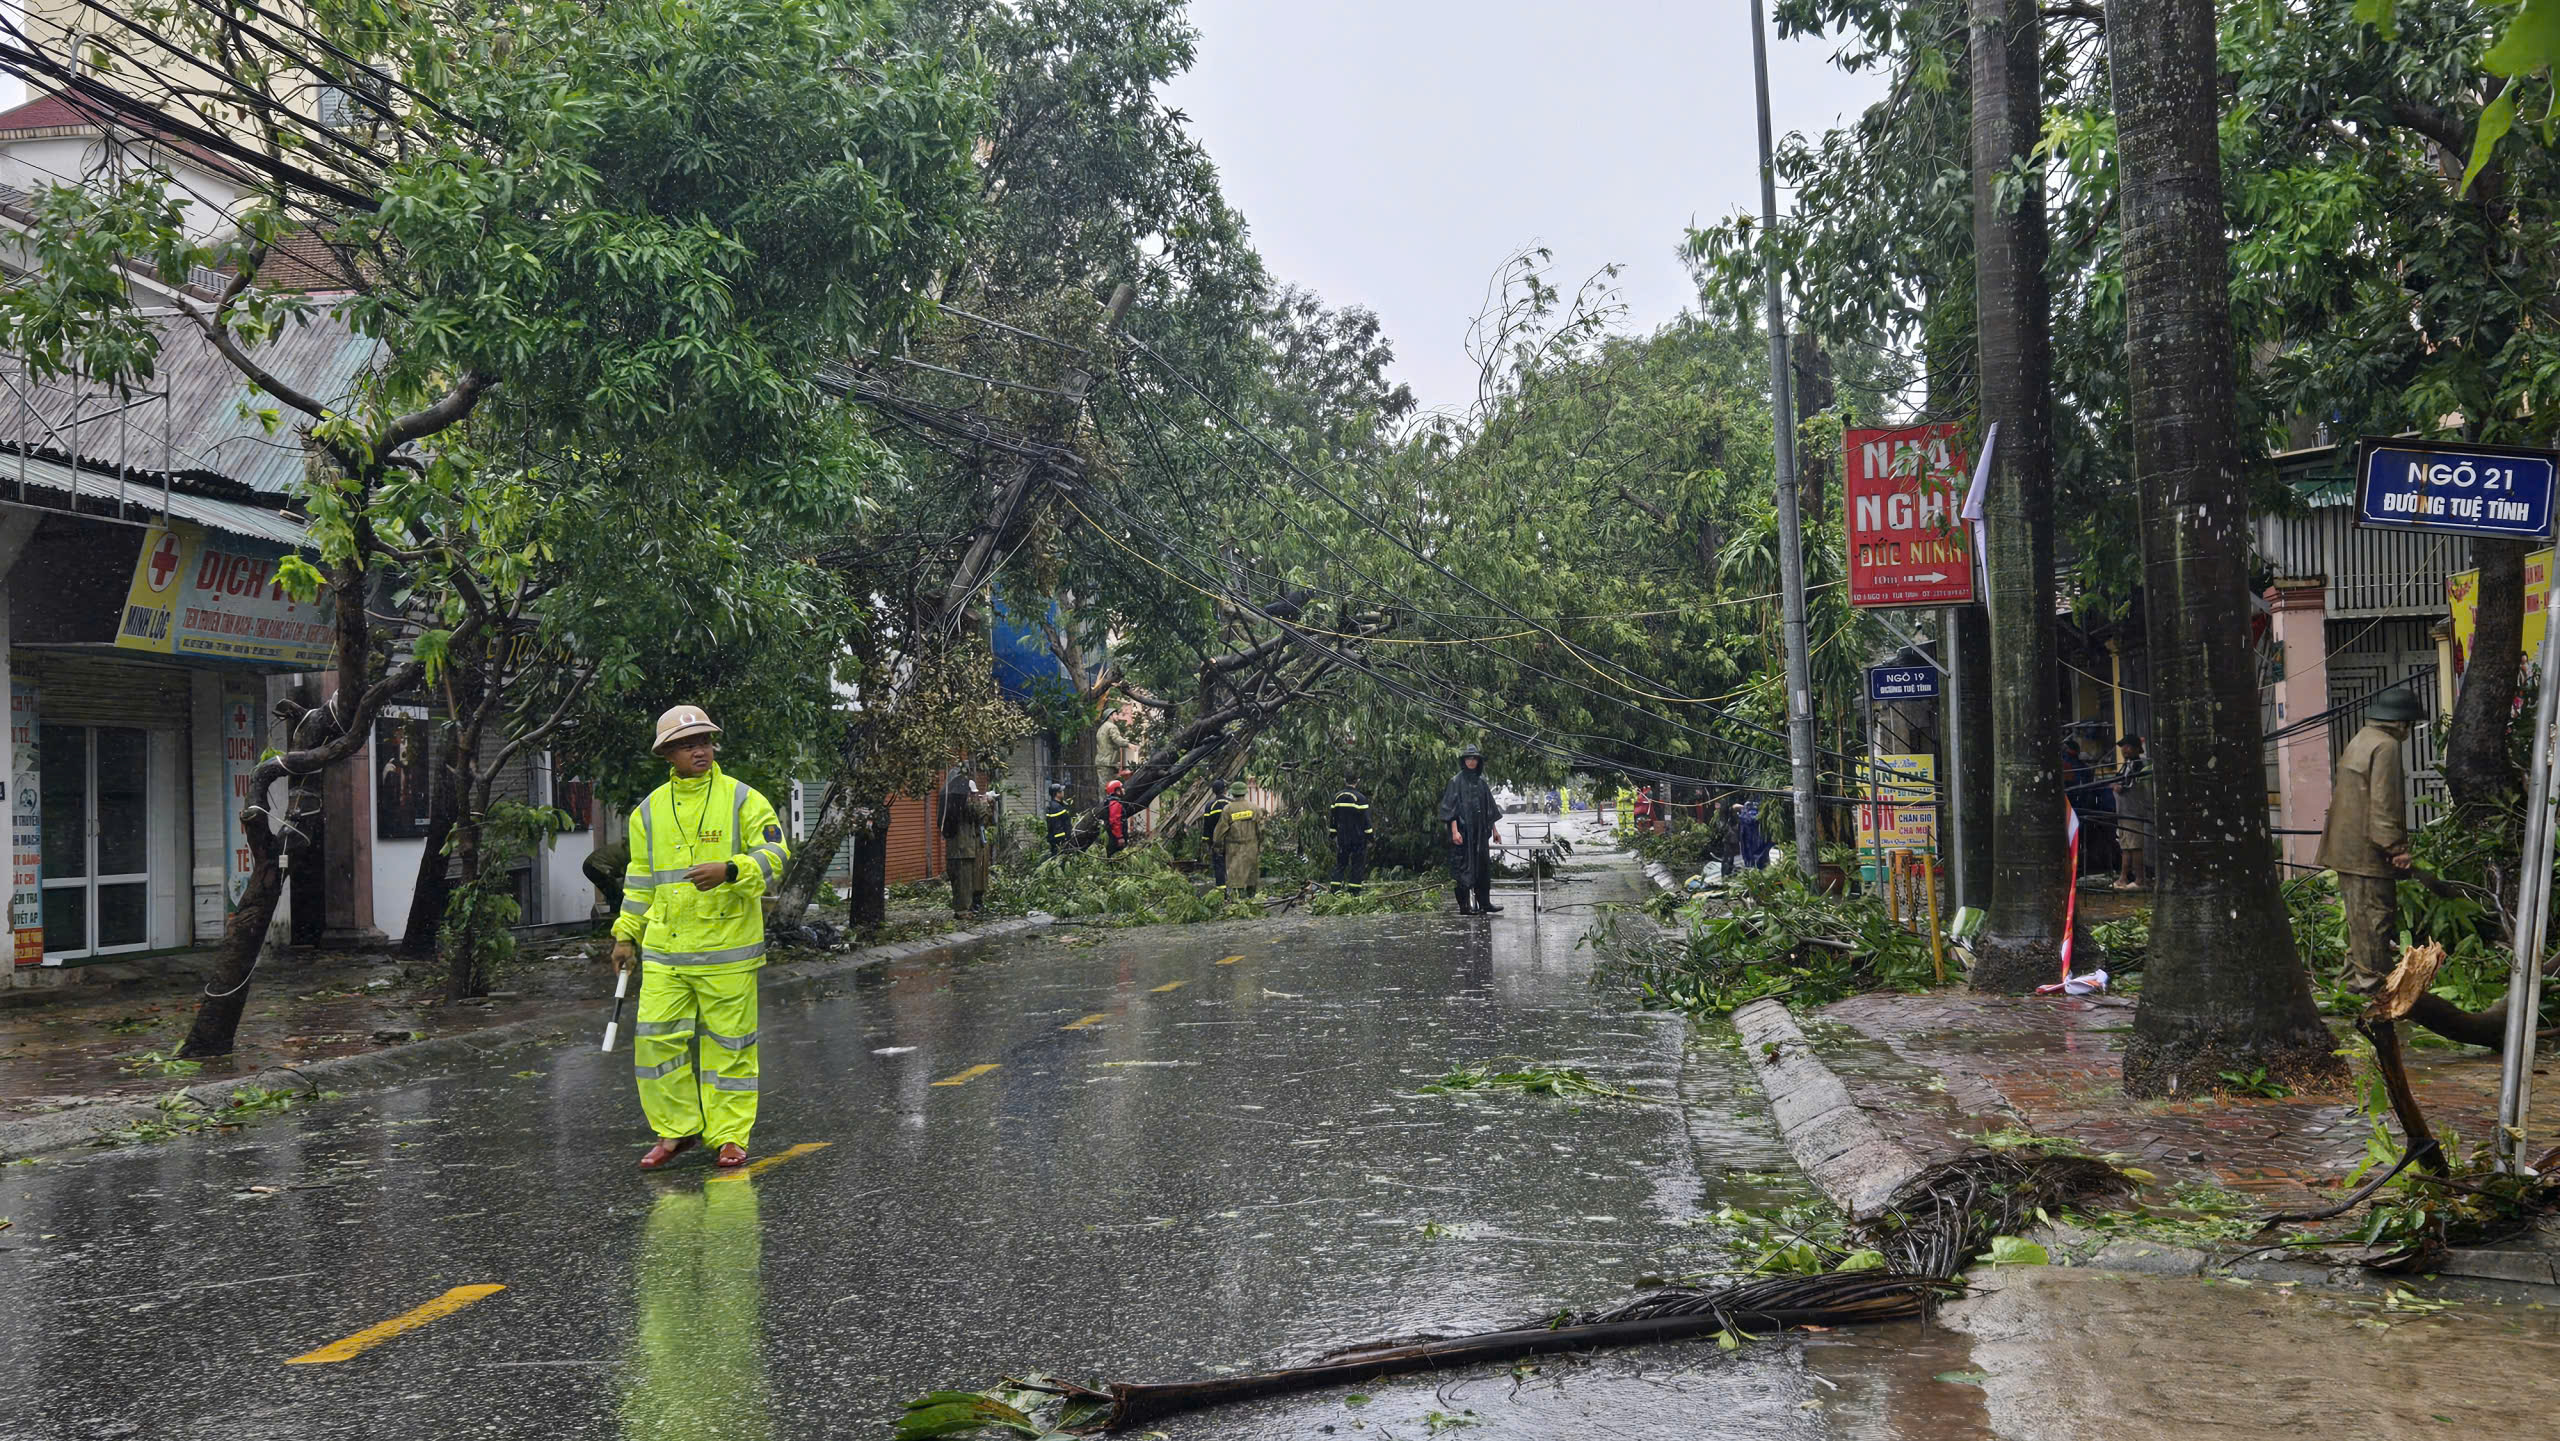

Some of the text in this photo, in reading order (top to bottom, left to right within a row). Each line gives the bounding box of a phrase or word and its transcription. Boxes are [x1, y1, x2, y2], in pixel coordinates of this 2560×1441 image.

[2408, 461, 2513, 490] NGÕ 21
[2383, 490, 2530, 521] ĐƯỜNG TUỆ TĨNH
[195, 549, 270, 601] DỊCH
[124, 604, 172, 645] MINH LỘC
[1914, 672, 1925, 681] 19
